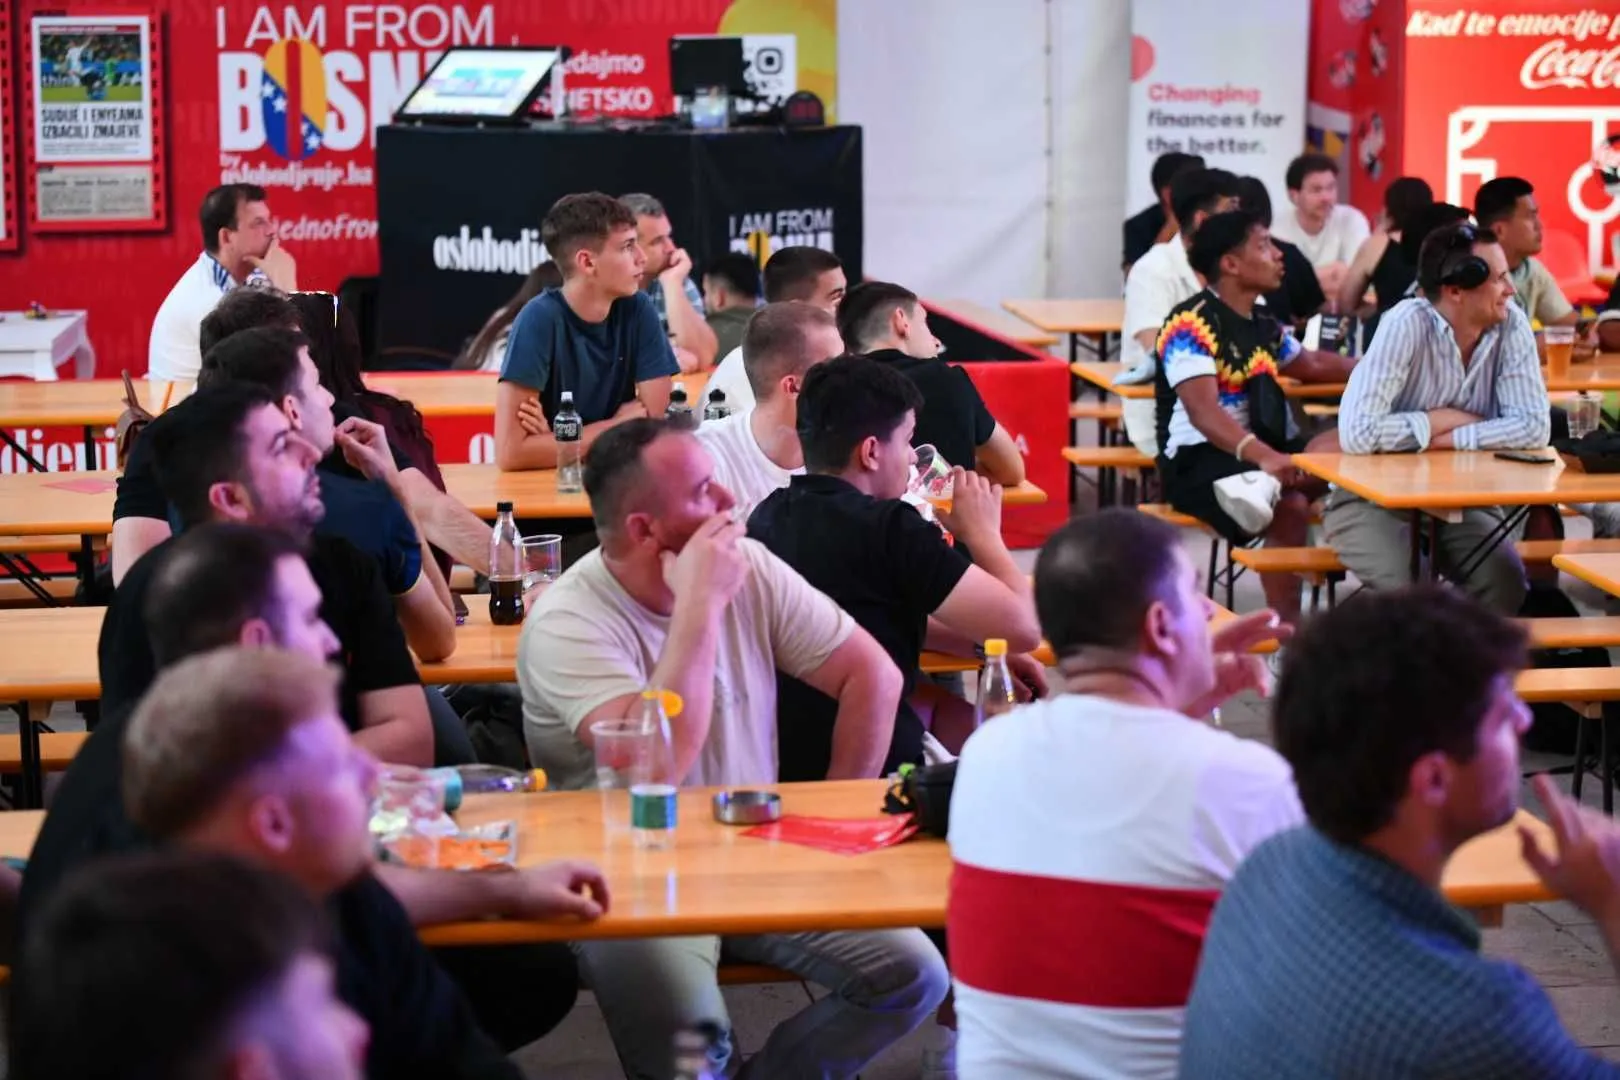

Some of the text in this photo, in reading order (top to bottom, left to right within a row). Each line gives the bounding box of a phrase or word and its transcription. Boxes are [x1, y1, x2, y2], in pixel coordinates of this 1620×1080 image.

[216, 5, 495, 48] I AM FROM
[1406, 9, 1465, 36] Kad
[1465, 11, 1496, 36] te
[563, 49, 645, 80] dajmo
[218, 51, 443, 161] BOSN
[1149, 83, 1262, 107] Changing
[1147, 108, 1284, 128] finances for
[1147, 136, 1182, 153] the
[729, 208, 833, 237] I AM FROM
